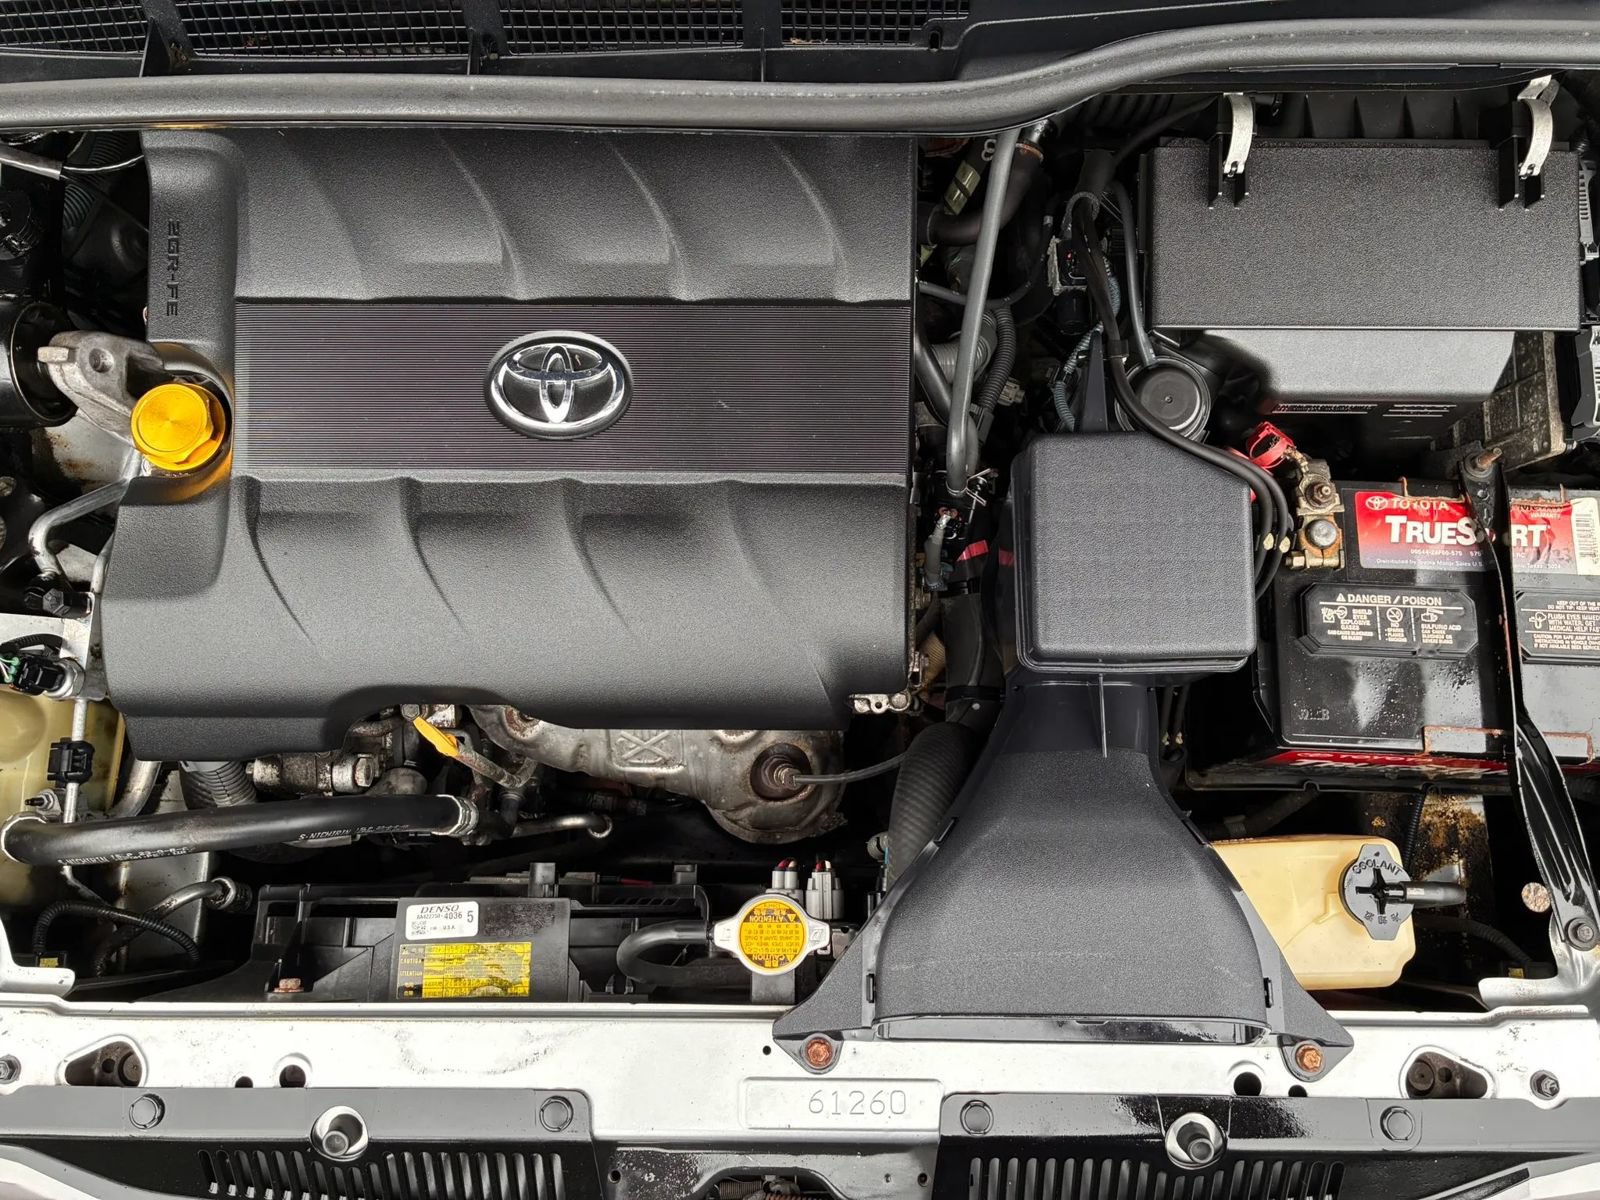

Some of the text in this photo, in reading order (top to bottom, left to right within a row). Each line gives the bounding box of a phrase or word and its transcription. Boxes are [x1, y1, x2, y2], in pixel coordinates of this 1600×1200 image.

[166, 219, 180, 316] 2GR-FE
[1391, 498, 1449, 511] TOYOTA
[1348, 594, 1392, 604] DANGER
[1402, 596, 1442, 606] POISON
[1352, 858, 1403, 876] COOLANT
[420, 904, 460, 913] DENSO
[466, 910, 475, 923] 5
[752, 953, 786, 961] CAUTION
[808, 1089, 906, 1115] 61260
